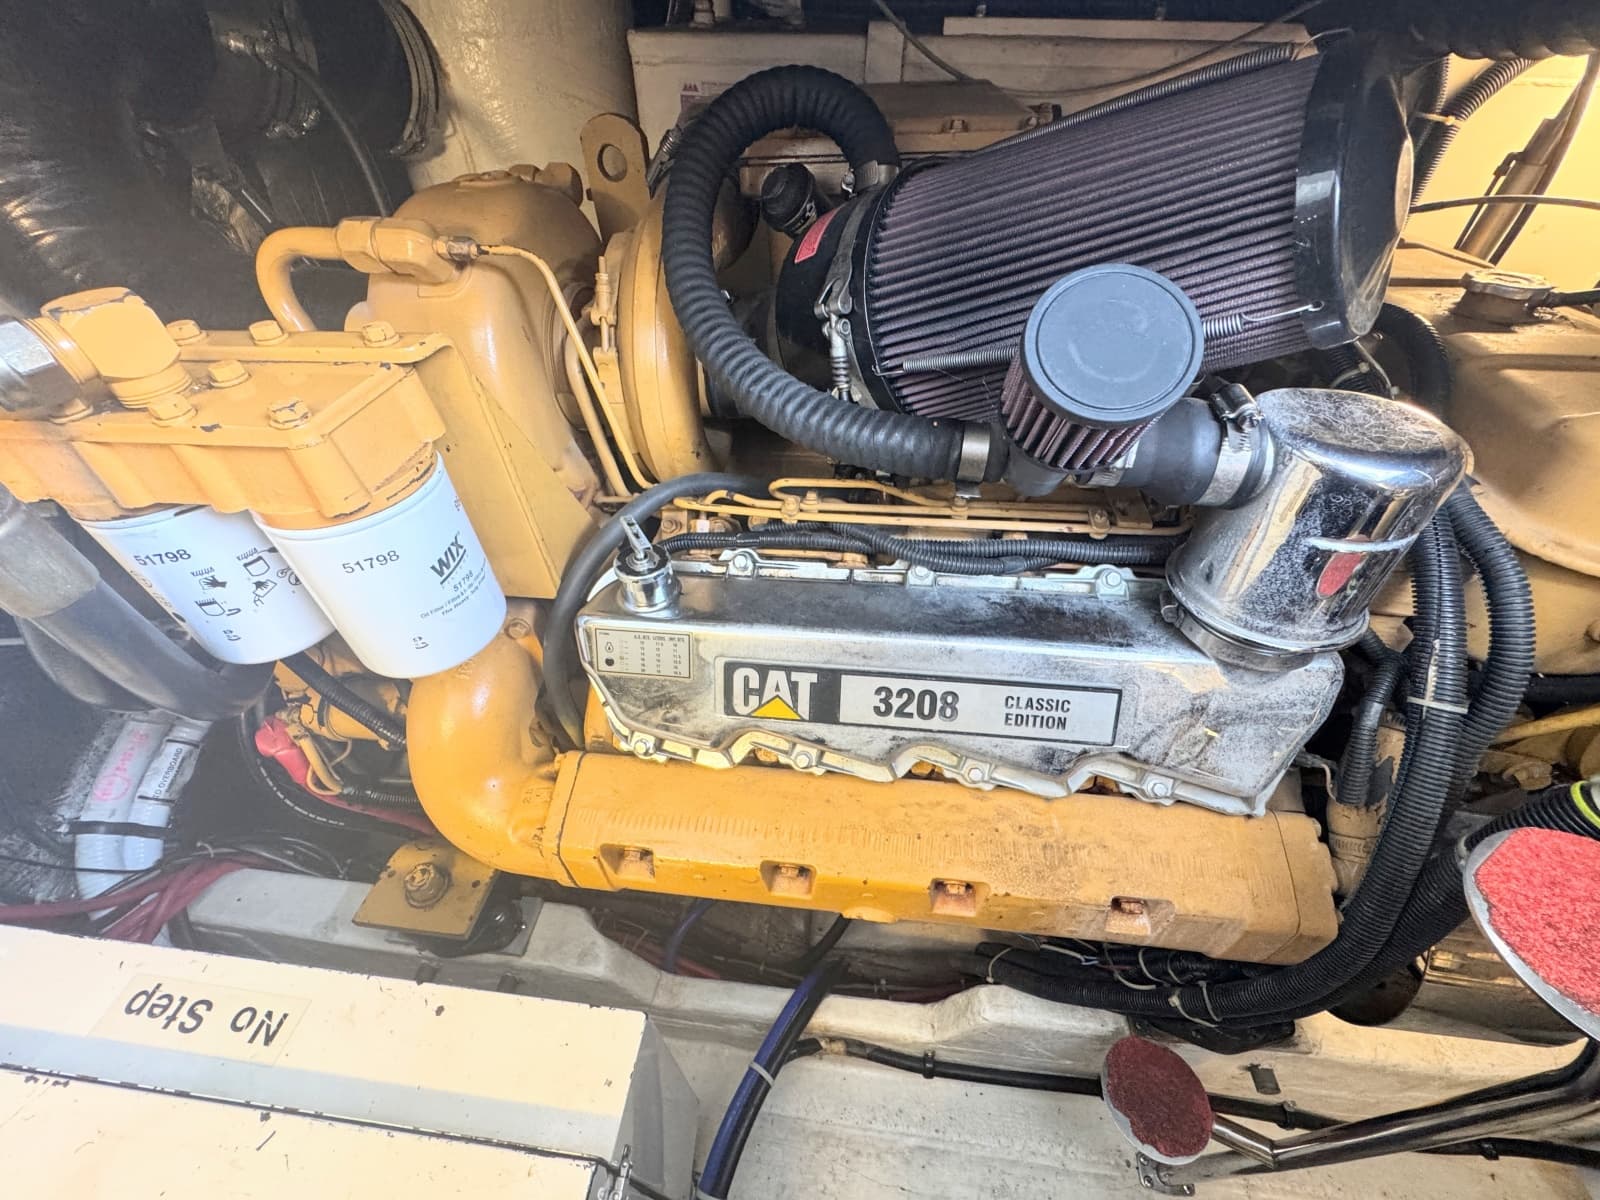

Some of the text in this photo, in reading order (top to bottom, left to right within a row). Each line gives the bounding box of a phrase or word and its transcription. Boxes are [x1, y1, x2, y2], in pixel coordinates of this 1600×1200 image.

[133, 548, 192, 567] 51798
[342, 549, 400, 574] 51798
[430, 534, 464, 577] WIX
[733, 667, 818, 720] CAT
[873, 686, 960, 722] 3208
[1004, 695, 1071, 713] CLASSIC
[1004, 712, 1067, 730] EDITION
[158, 747, 183, 790] OVERBOARD
[124, 983, 289, 1046] No Step
